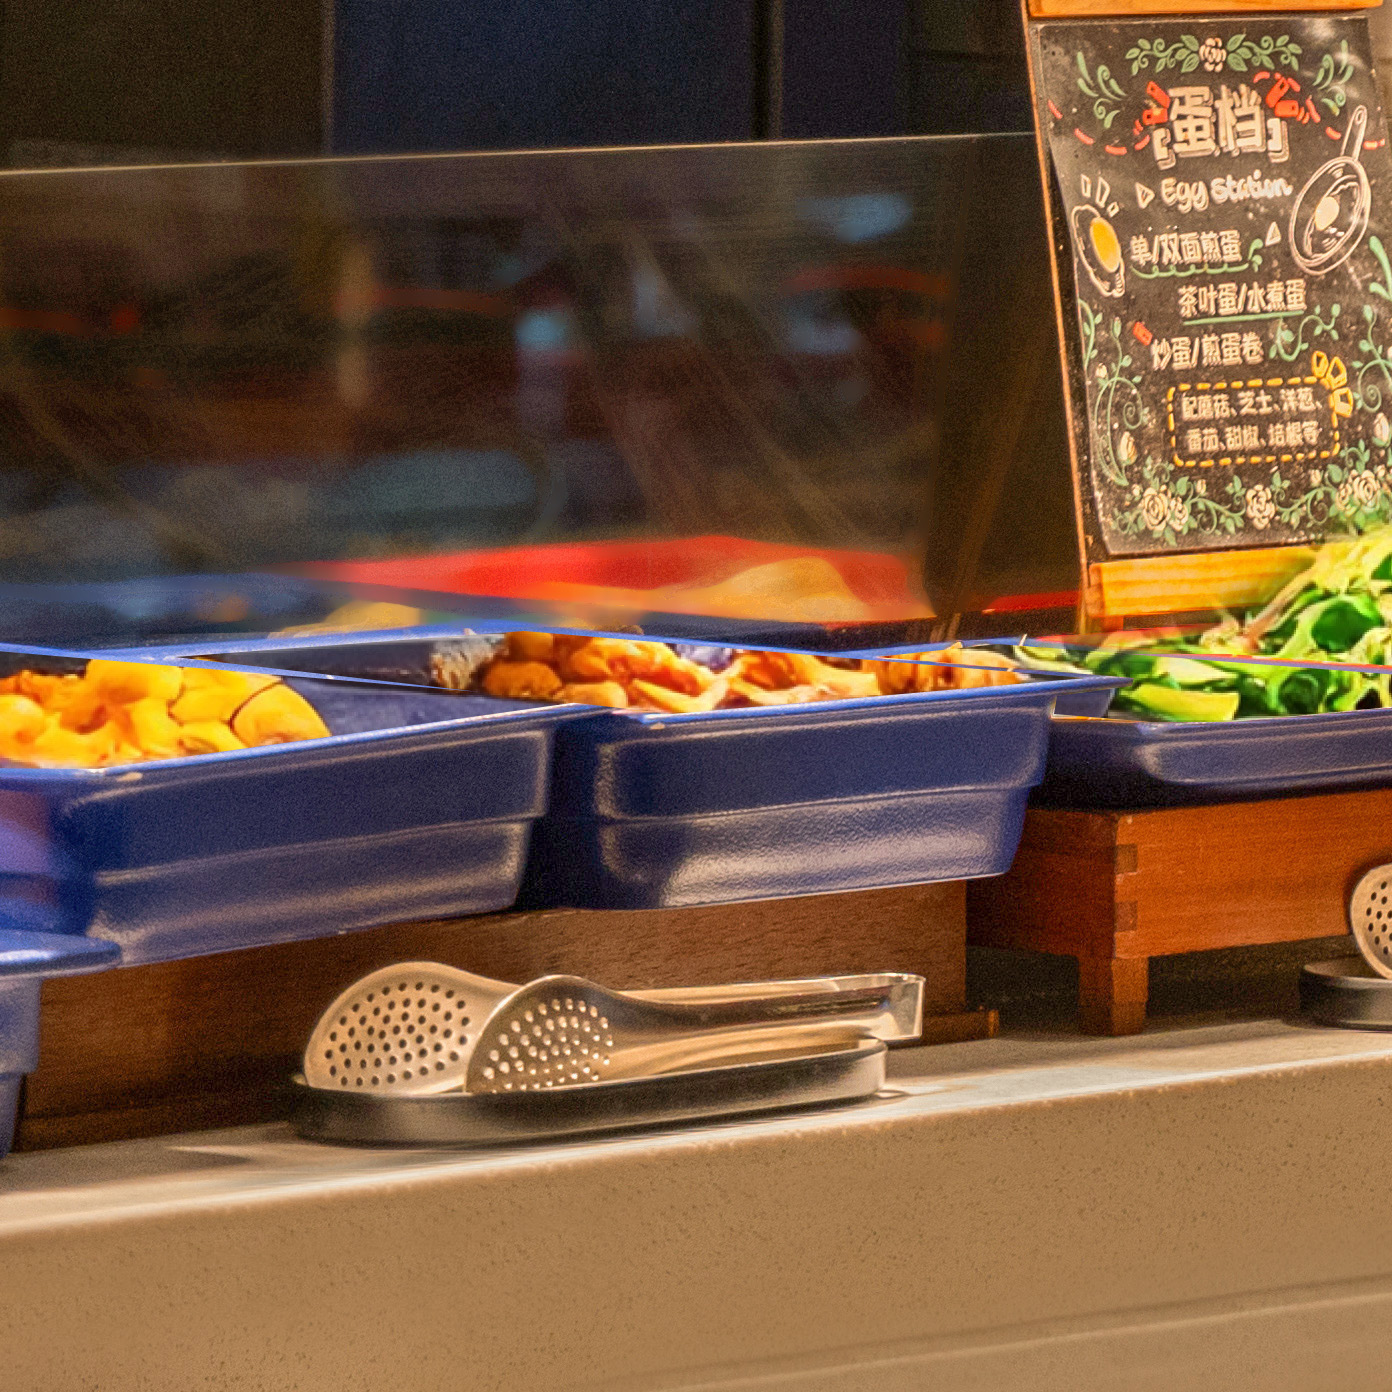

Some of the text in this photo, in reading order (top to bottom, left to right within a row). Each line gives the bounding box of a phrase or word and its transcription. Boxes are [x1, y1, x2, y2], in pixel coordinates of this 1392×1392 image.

[1161, 169, 1293, 214] Egg Station
[1130, 229, 1243, 266] 单/双面煎蛋
[1178, 278, 1308, 318] 茶叶蛋/水煮蛋
[1151, 331, 1264, 370] 炒蛋/煎蛋卷
